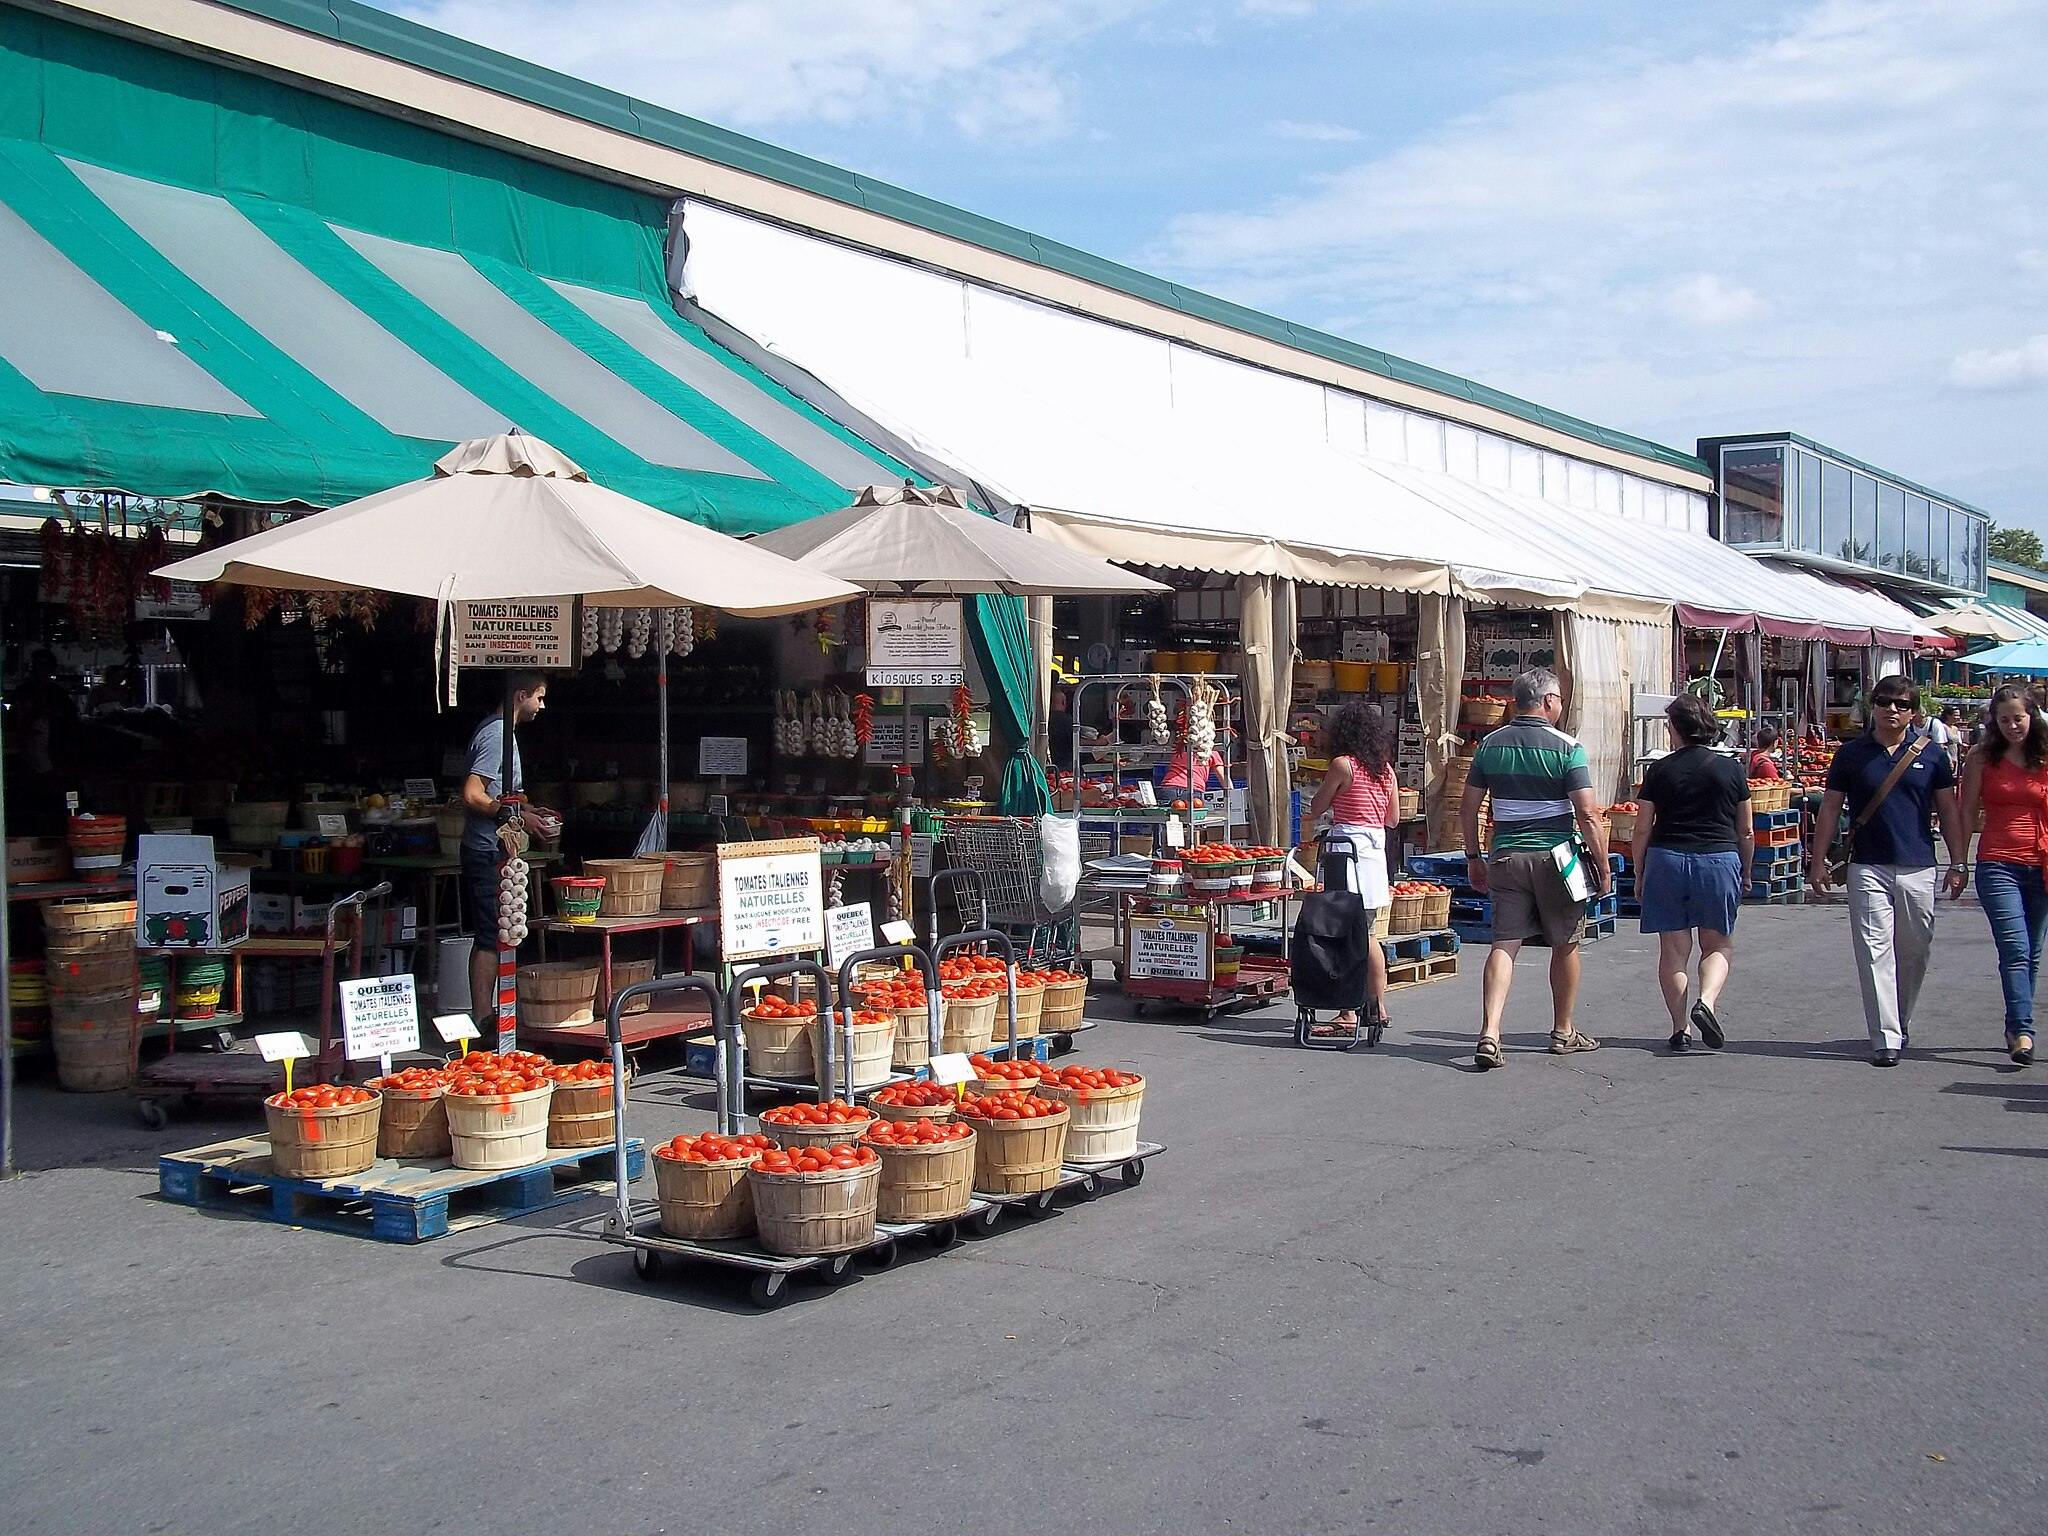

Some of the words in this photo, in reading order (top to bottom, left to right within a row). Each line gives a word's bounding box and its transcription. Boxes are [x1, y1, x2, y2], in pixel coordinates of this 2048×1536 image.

[468, 604, 507, 617] TOMATES
[509, 604, 559, 619] ITALIENNES
[473, 621, 552, 632] NATURELLES
[489, 641, 532, 650] INSECTICIDE
[931, 673, 963, 685] 52-53
[734, 874, 767, 892] TOMATES
[768, 871, 809, 889] ITALIENNES
[740, 891, 805, 908] NATURELLES
[736, 923, 753, 931] SANS
[792, 916, 811, 925] FREE
[1140, 930, 1165, 941] TOMATES
[1166, 931, 1198, 943] ITALIENNES
[1143, 942, 1194, 953] NATURELLES
[357, 983, 403, 996] QUEBEC
[355, 1008, 409, 1022] NATURELLES
